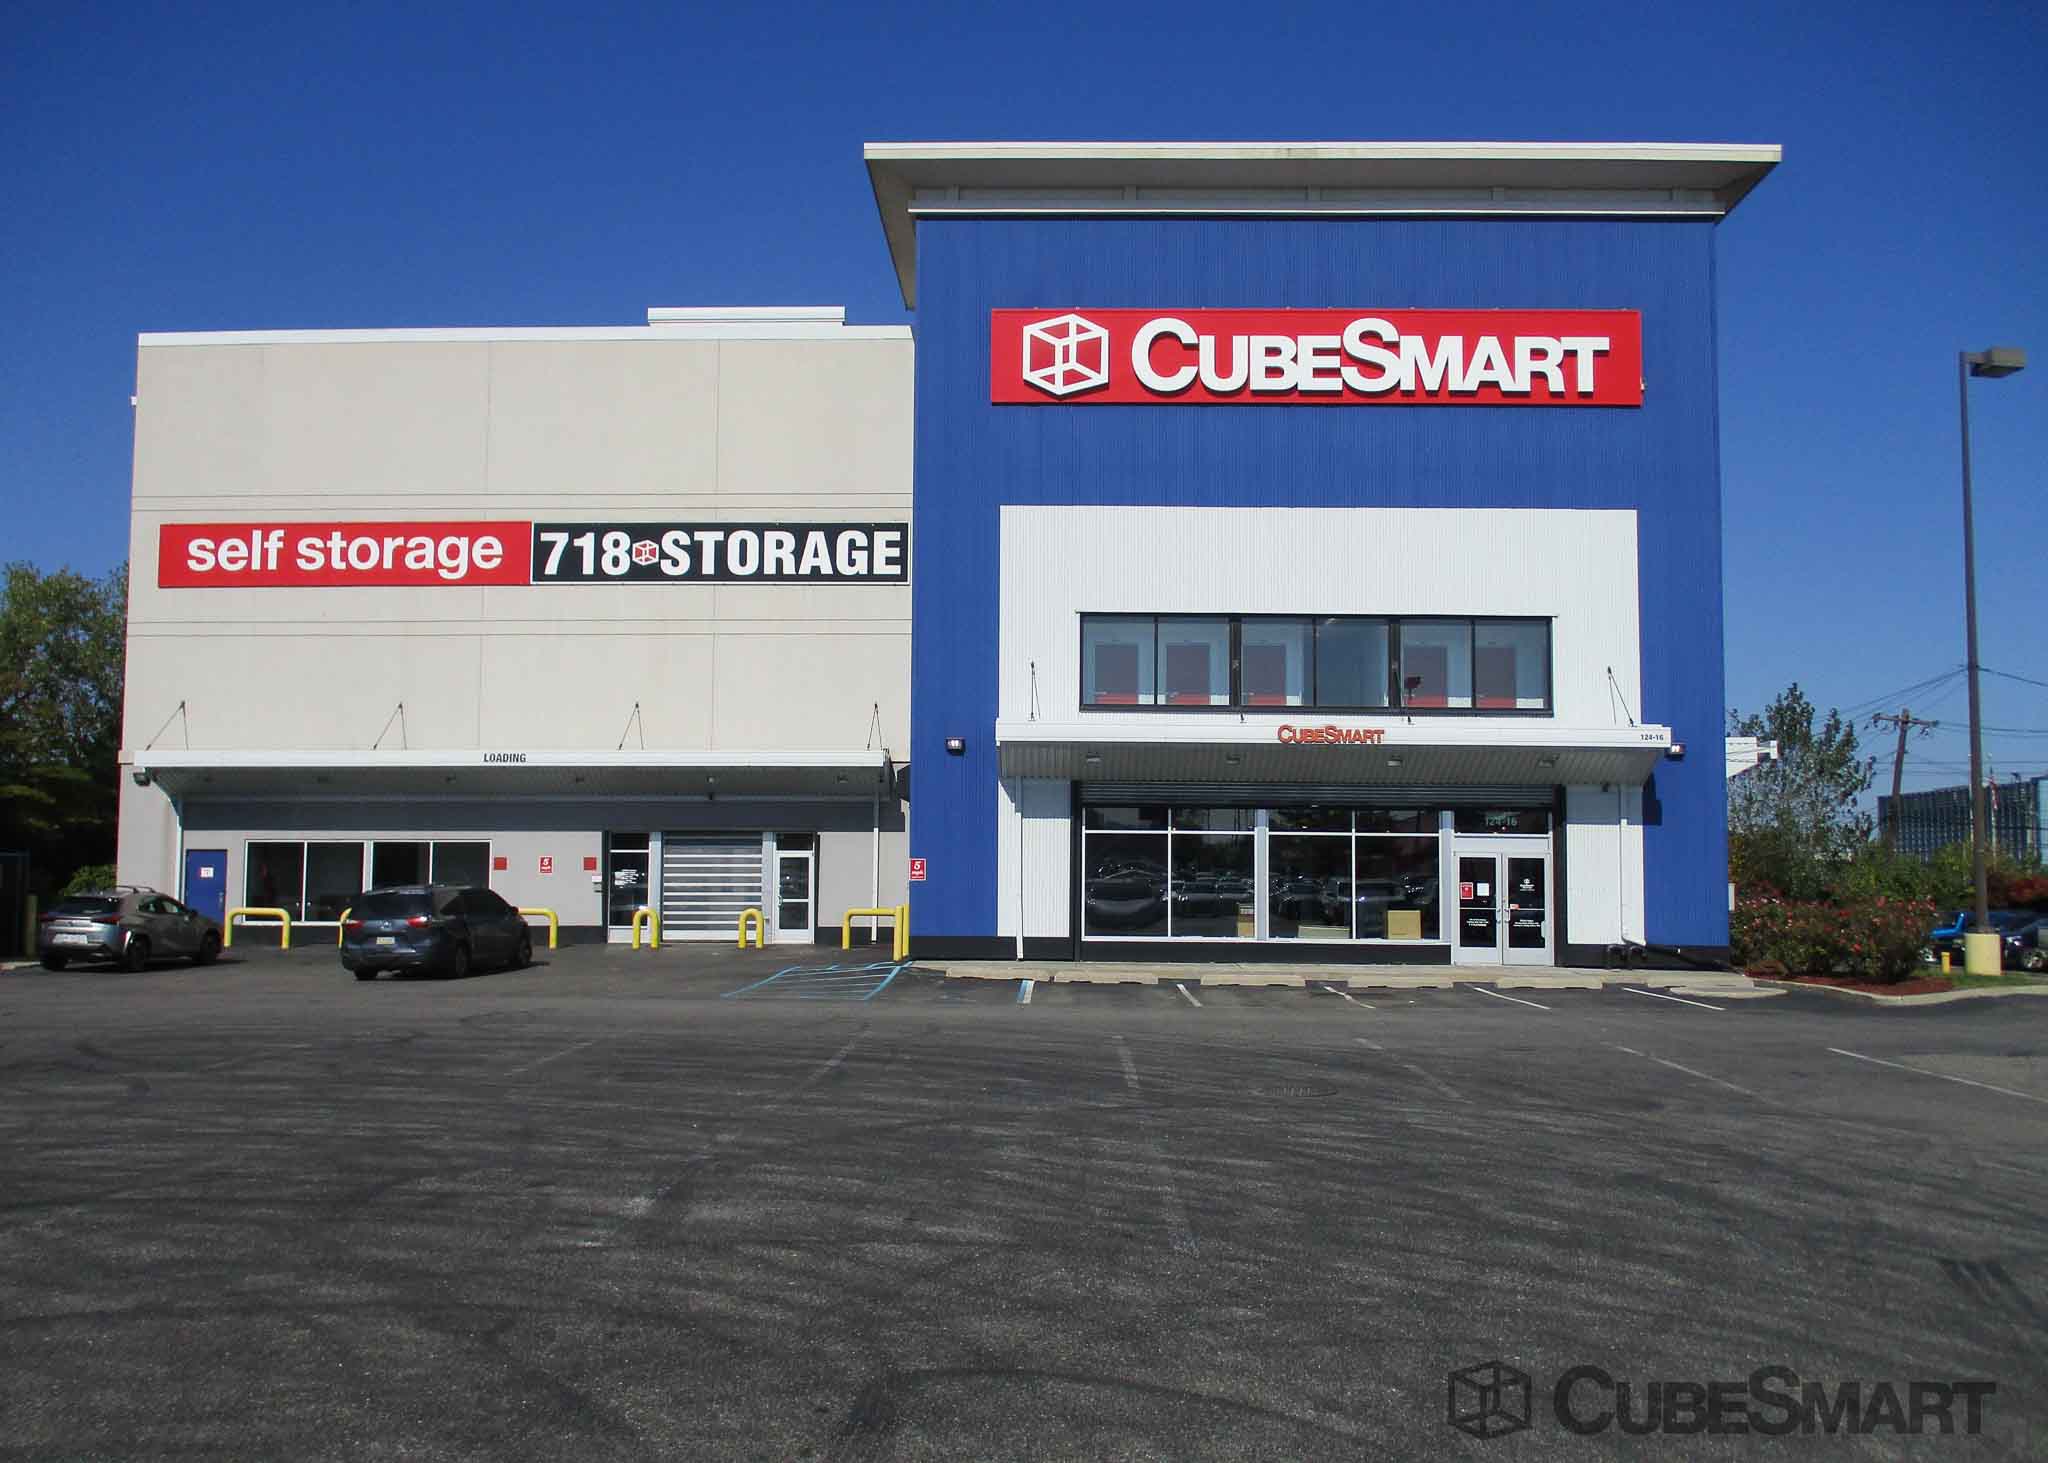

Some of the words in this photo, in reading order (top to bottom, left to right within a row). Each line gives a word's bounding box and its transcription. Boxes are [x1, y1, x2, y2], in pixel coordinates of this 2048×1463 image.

[187, 529, 284, 571] self
[296, 531, 503, 579] storage
[540, 530, 631, 576] 718
[660, 529, 901, 577] STORAGE
[1640, 733, 1664, 741] 124-16
[483, 752, 527, 763] LOADING
